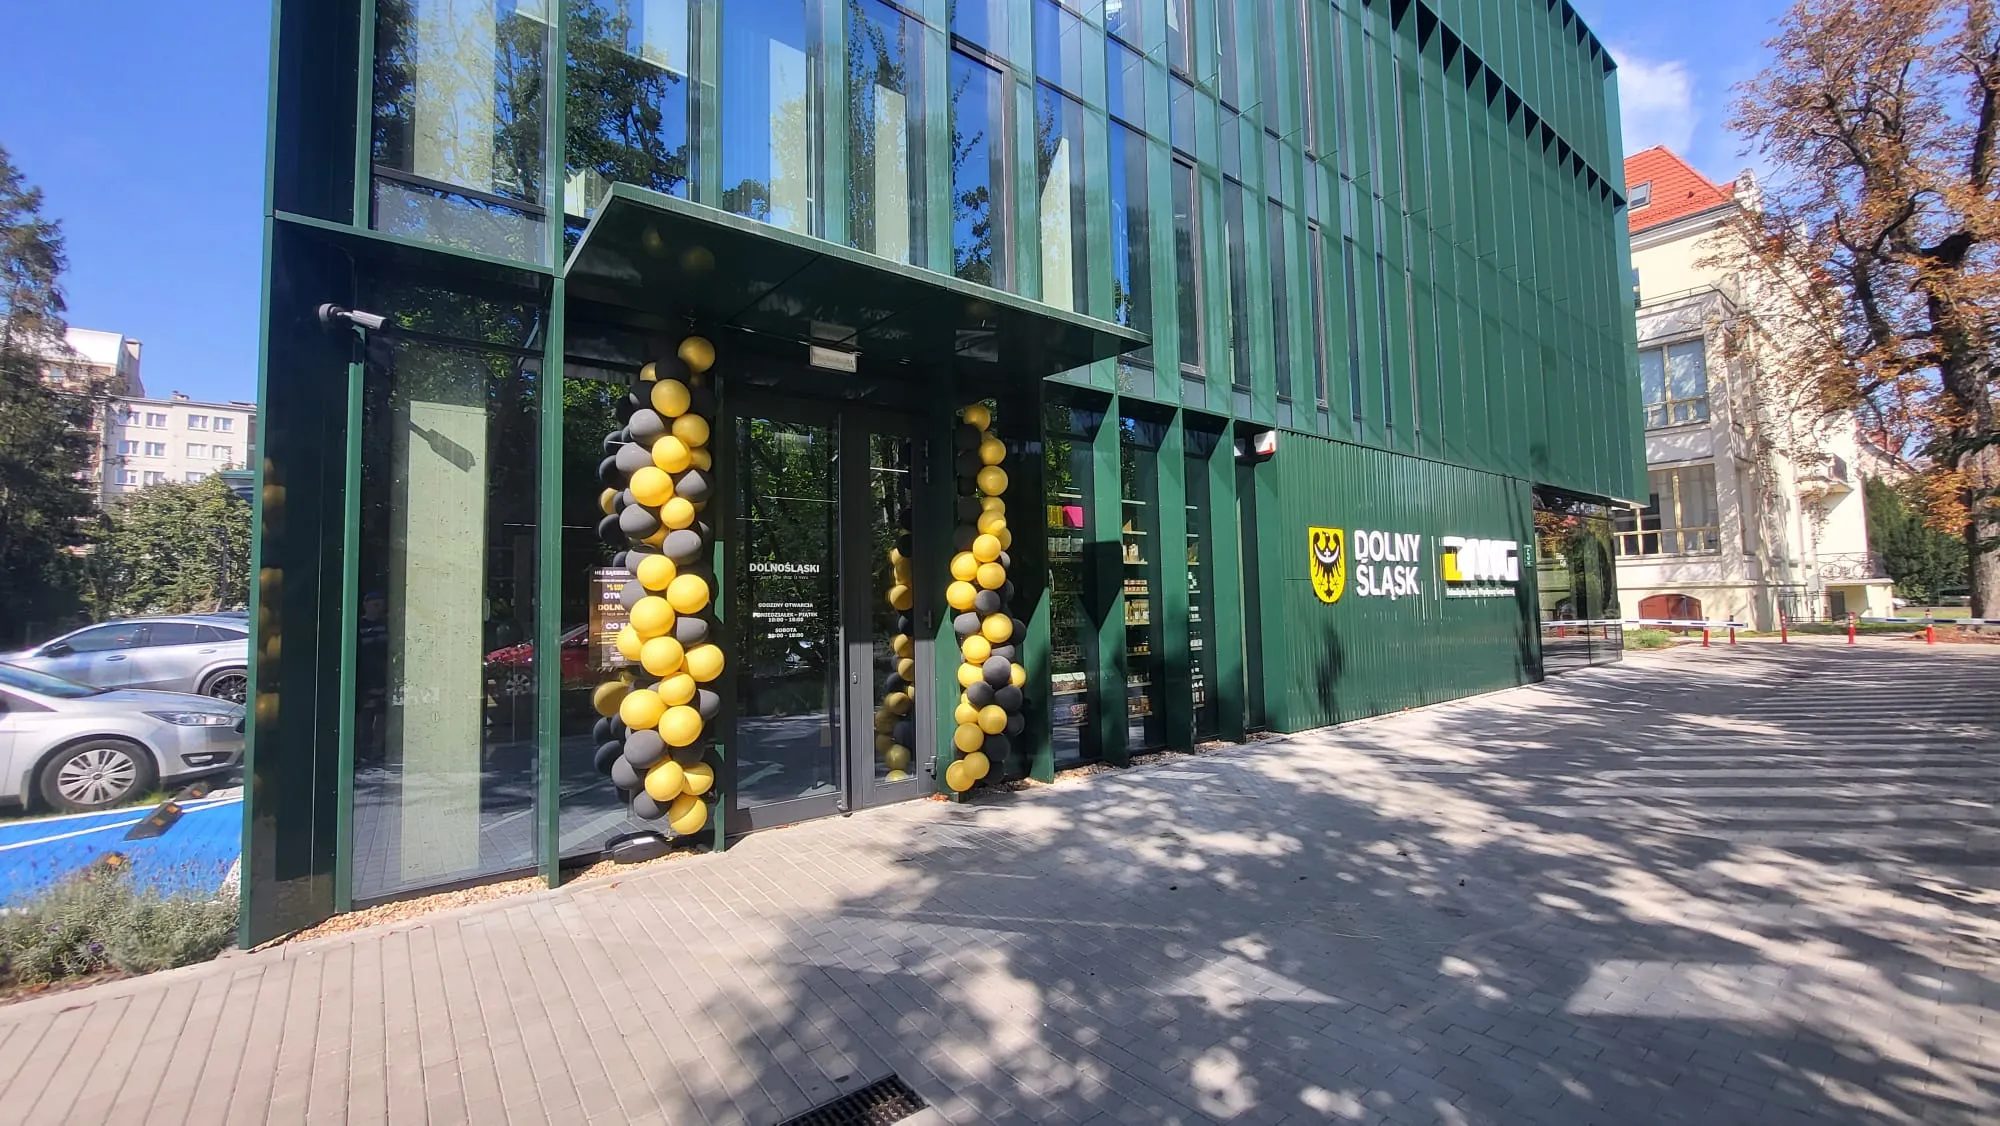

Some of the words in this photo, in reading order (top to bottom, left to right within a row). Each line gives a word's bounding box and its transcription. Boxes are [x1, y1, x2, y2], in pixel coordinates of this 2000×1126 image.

[1354, 529, 1421, 562] DOLNY
[749, 562, 820, 574] DOLNOŚLĄSKI
[1356, 558, 1420, 600] ŚLĄSK
